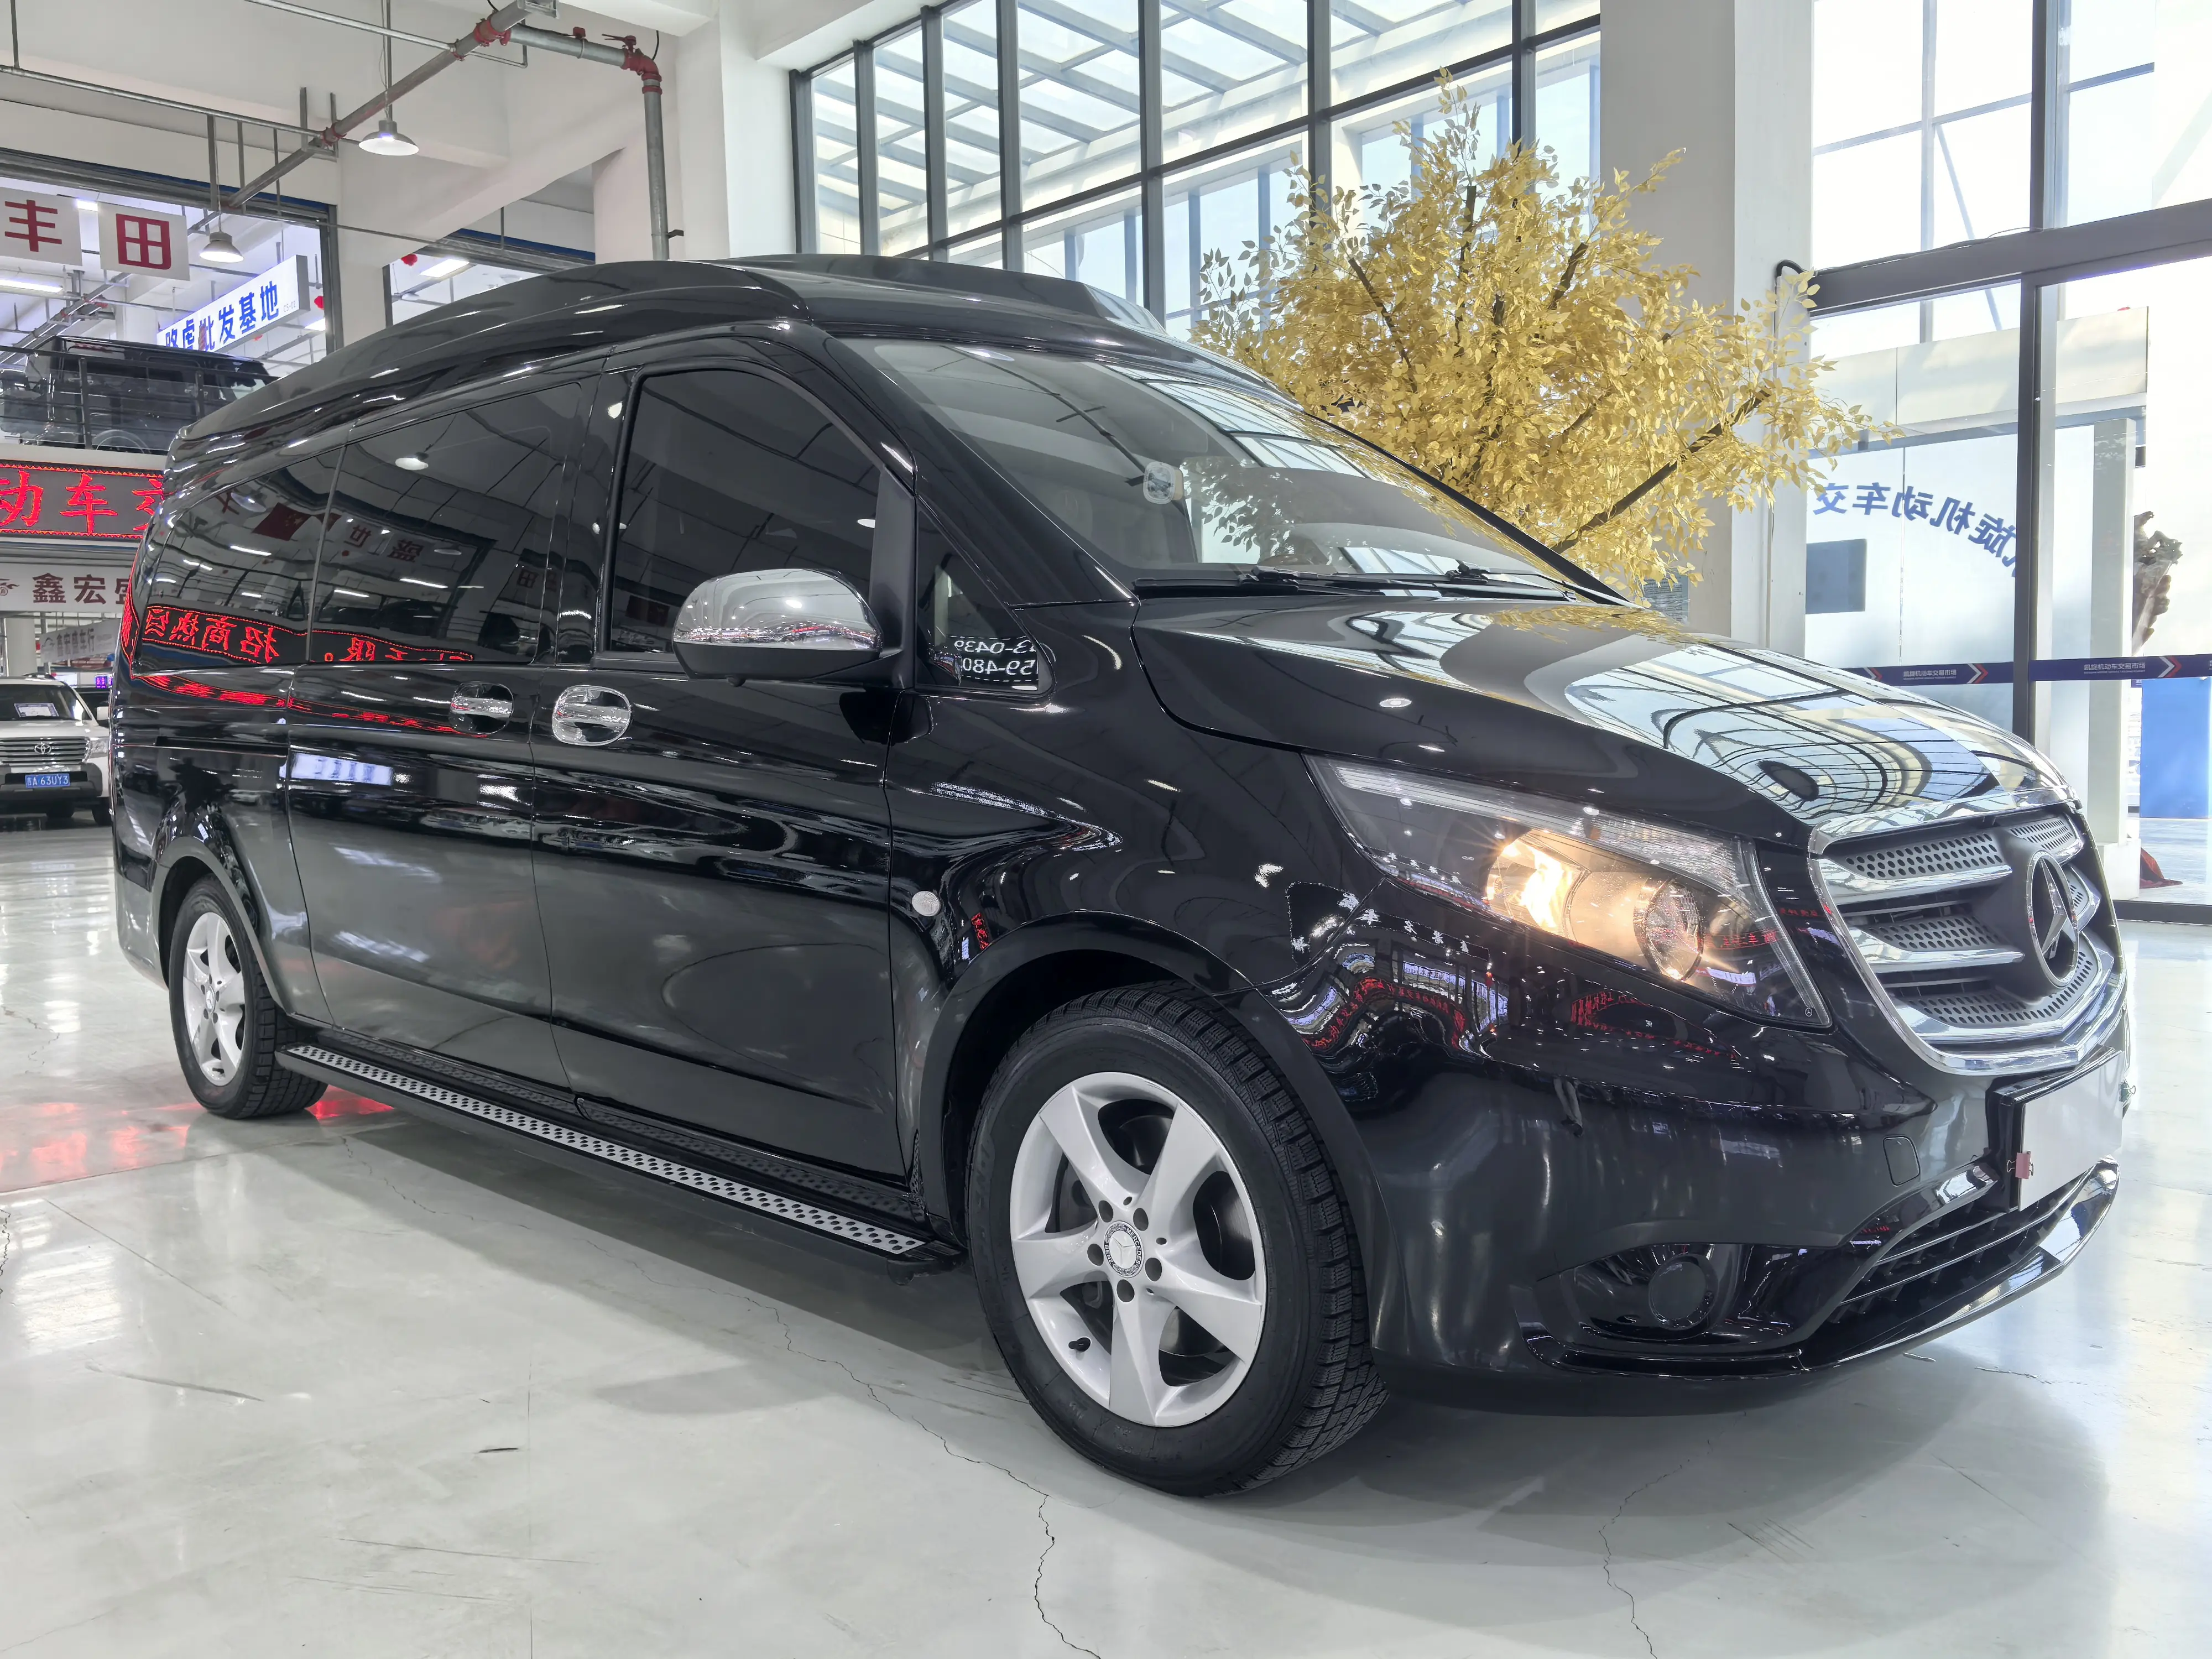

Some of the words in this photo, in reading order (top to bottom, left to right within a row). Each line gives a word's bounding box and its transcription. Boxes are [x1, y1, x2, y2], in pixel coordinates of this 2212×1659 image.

[4, 199, 171, 270] 丰田
[1104, 1244, 1114, 1265] BENZ
[1126, 1227, 1141, 1265] MERCEDES
